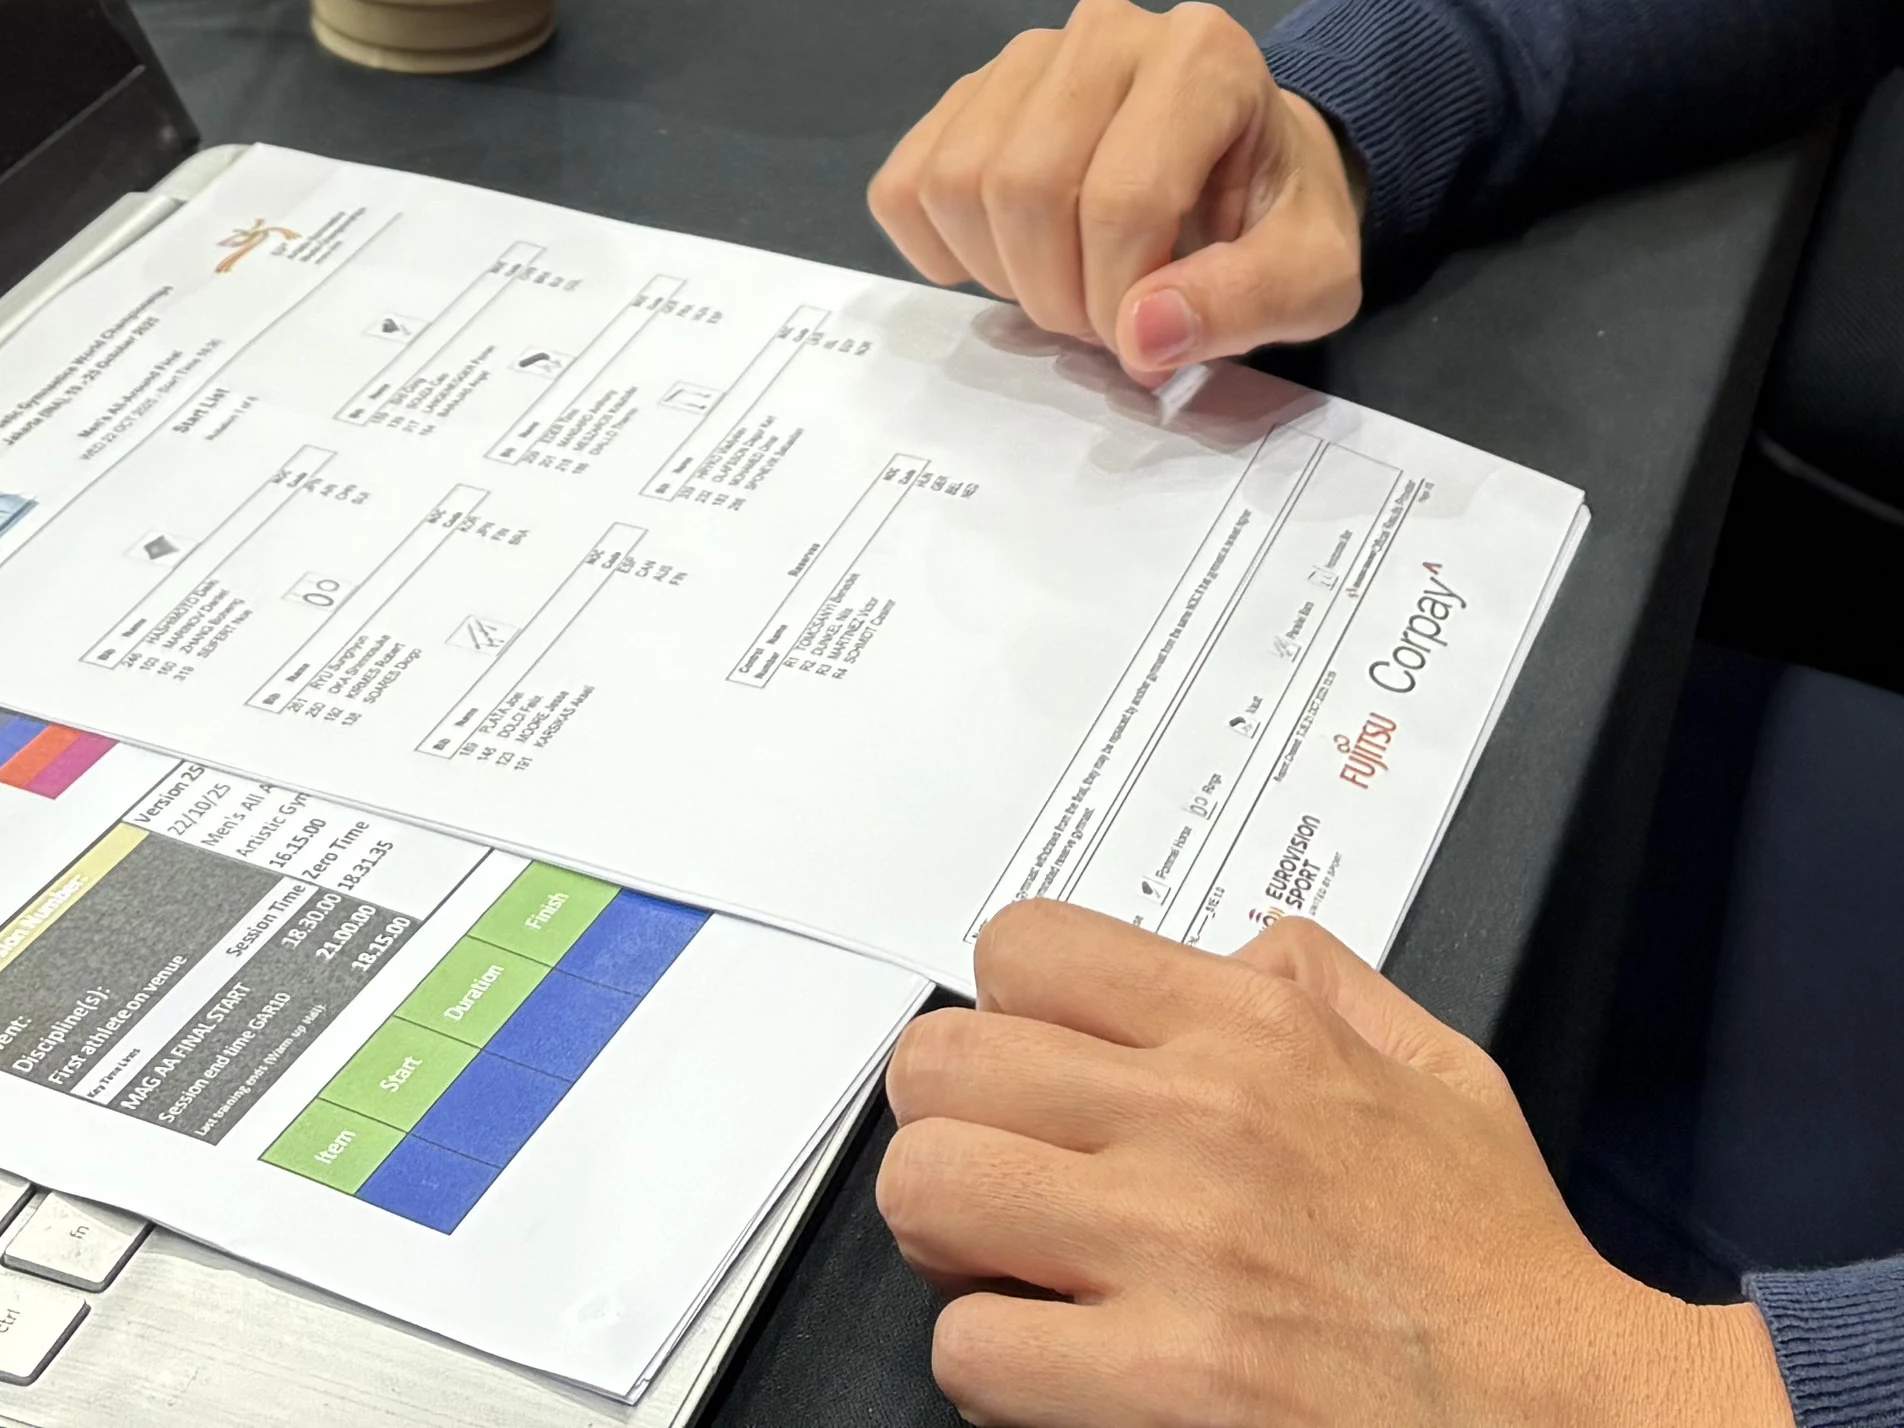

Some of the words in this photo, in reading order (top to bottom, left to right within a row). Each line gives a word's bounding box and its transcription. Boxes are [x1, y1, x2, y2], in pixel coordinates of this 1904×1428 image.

[17, 367, 78, 410] Gymnastics
[72, 340, 106, 364] World
[173, 409, 208, 433] Start
[200, 388, 230, 408] List
[497, 713, 526, 738] DOLCI
[635, 560, 656, 577] CAN
[811, 624, 843, 656] DUNKEL
[827, 618, 865, 659] MARTINEZ
[1369, 577, 1466, 693] Corpay
[515, 712, 550, 743] MOORE
[534, 708, 576, 747] KARSIKAS
[1340, 712, 1398, 789] FUJITSU
[134, 782, 189, 822] Version
[167, 784, 231, 836] 22/10/25
[201, 813, 245, 846] Men's
[240, 793, 264, 811] All
[236, 817, 286, 857] Artistic
[269, 819, 326, 868] 16.15.00
[302, 852, 338, 879] Zero
[329, 822, 369, 849] Time
[1265, 815, 1320, 900] EUROVISION
[338, 841, 393, 891] 18.31.35
[1285, 859, 1320, 910] SPORT
[226, 914, 277, 957] Session
[268, 885, 305, 911] Time
[282, 894, 341, 949] 18.30.00
[316, 905, 376, 960] 21.00.00
[349, 913, 414, 974] 18.15.00
[12, 987, 110, 1072] Discipline(s):
[48, 1055, 86, 1084] First
[81, 1010, 132, 1055] athlete
[126, 992, 149, 1010] on
[143, 956, 187, 991] venue
[121, 1077, 161, 1109] MAG
[154, 1057, 181, 1077] AA
[171, 1024, 216, 1058] FINAL
[207, 982, 250, 1022] START
[314, 1131, 356, 1164] Item
[380, 1056, 422, 1092] Start
[444, 965, 504, 1021] Duration
[525, 893, 569, 929] Finish
[159, 1079, 209, 1123] Session
[203, 1055, 230, 1078] end
[223, 1030, 255, 1056] time
[248, 993, 290, 1029] GAR10
[195, 1118, 218, 1136] Last
[213, 1086, 251, 1118] training
[245, 1066, 268, 1085] ends
